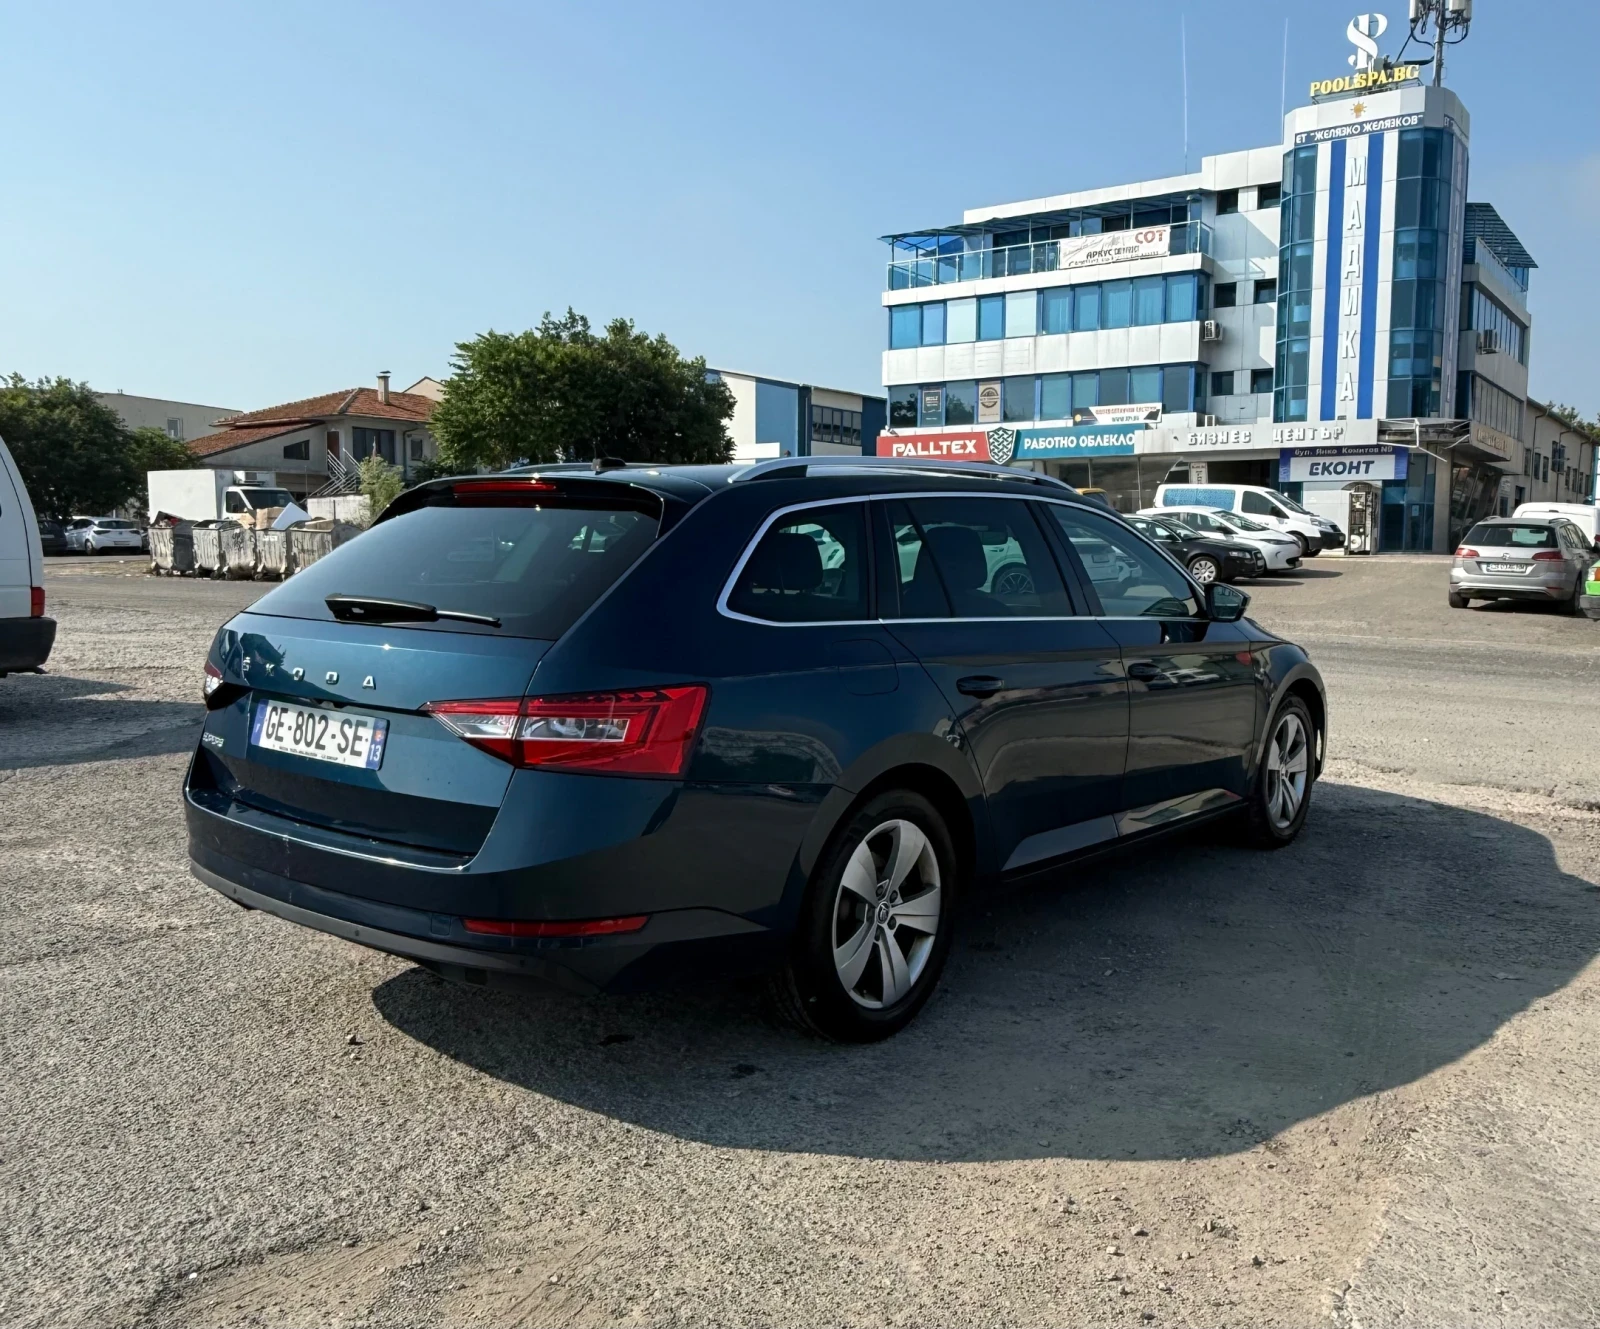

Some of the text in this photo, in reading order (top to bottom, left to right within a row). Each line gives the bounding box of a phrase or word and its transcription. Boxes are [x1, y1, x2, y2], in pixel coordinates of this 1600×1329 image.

[1134, 229, 1167, 244] СОТ
[1339, 156, 1367, 401] МАДИКА
[1024, 432, 1135, 450] РАБОТНО ОБЛЕКЛО
[1187, 426, 1344, 446] БИЗНЕС ЦЕНТЪР
[892, 439, 977, 457] PALLTEX
[1308, 460, 1375, 476] ЕКОНТ
[265, 705, 369, 758] GE-802-SE
[369, 743, 382, 762] 13
